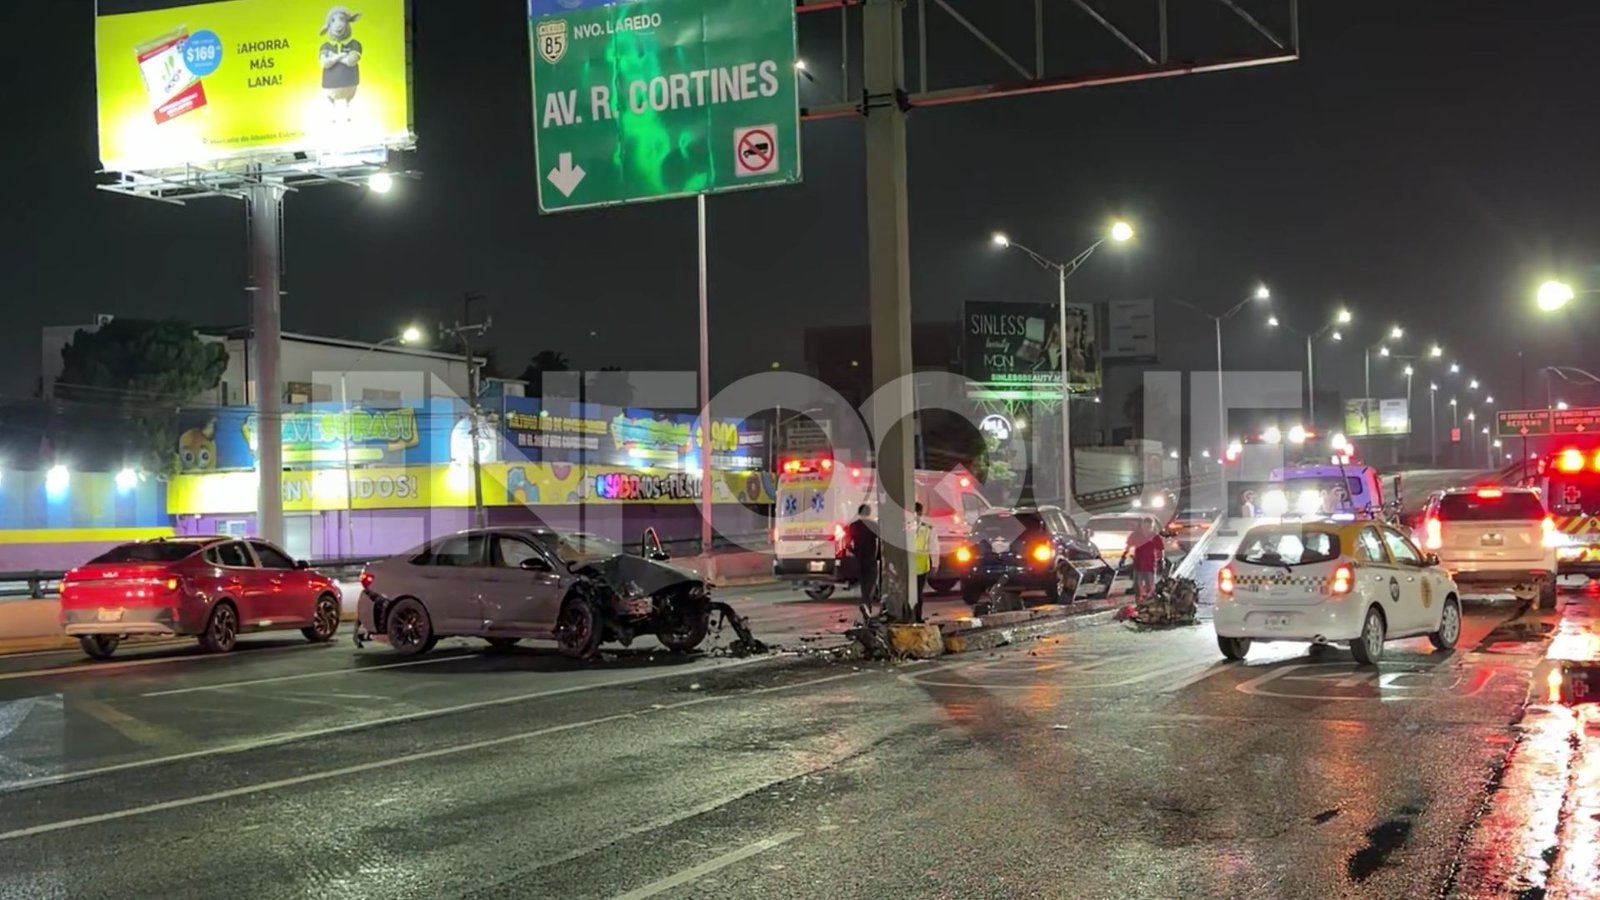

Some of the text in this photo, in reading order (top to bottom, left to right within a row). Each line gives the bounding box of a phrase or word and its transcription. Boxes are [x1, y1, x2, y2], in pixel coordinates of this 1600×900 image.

[573, 13, 662, 39] NVO. LAREDO
[237, 38, 290, 55] ¡AHORRA
[545, 36, 563, 55] 85
[250, 55, 275, 70] MÁS
[248, 75, 283, 88] LANA!
[543, 60, 779, 128] AV. R. CORTINES
[971, 314, 1026, 335] SINLESS
